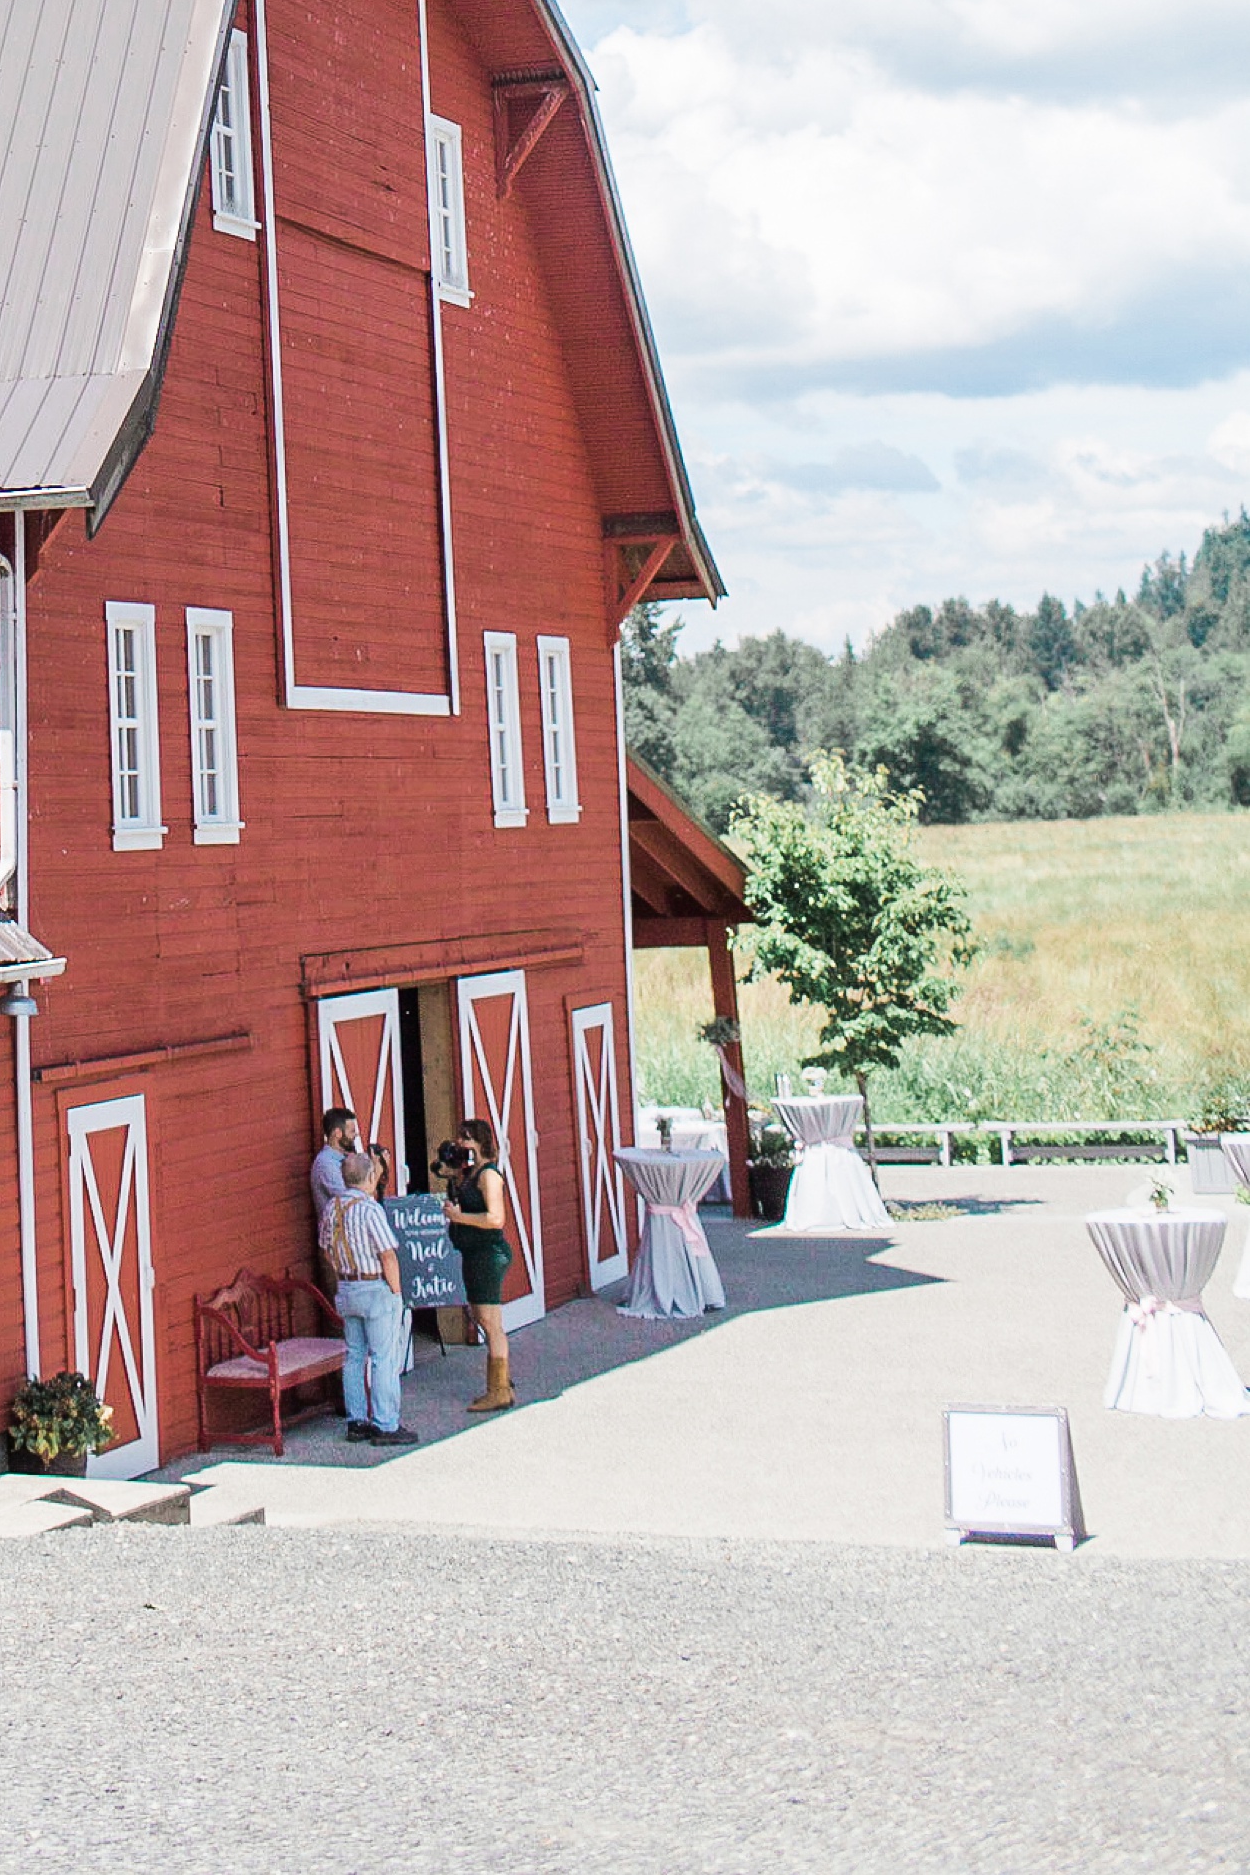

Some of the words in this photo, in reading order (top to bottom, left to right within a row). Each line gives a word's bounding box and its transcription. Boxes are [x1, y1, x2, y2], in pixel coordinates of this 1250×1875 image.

[405, 1238, 449, 1262] Neil
[411, 1275, 456, 1298] Katie
[971, 1460, 1032, 1483] Vehicles
[976, 1489, 1031, 1510] Please
